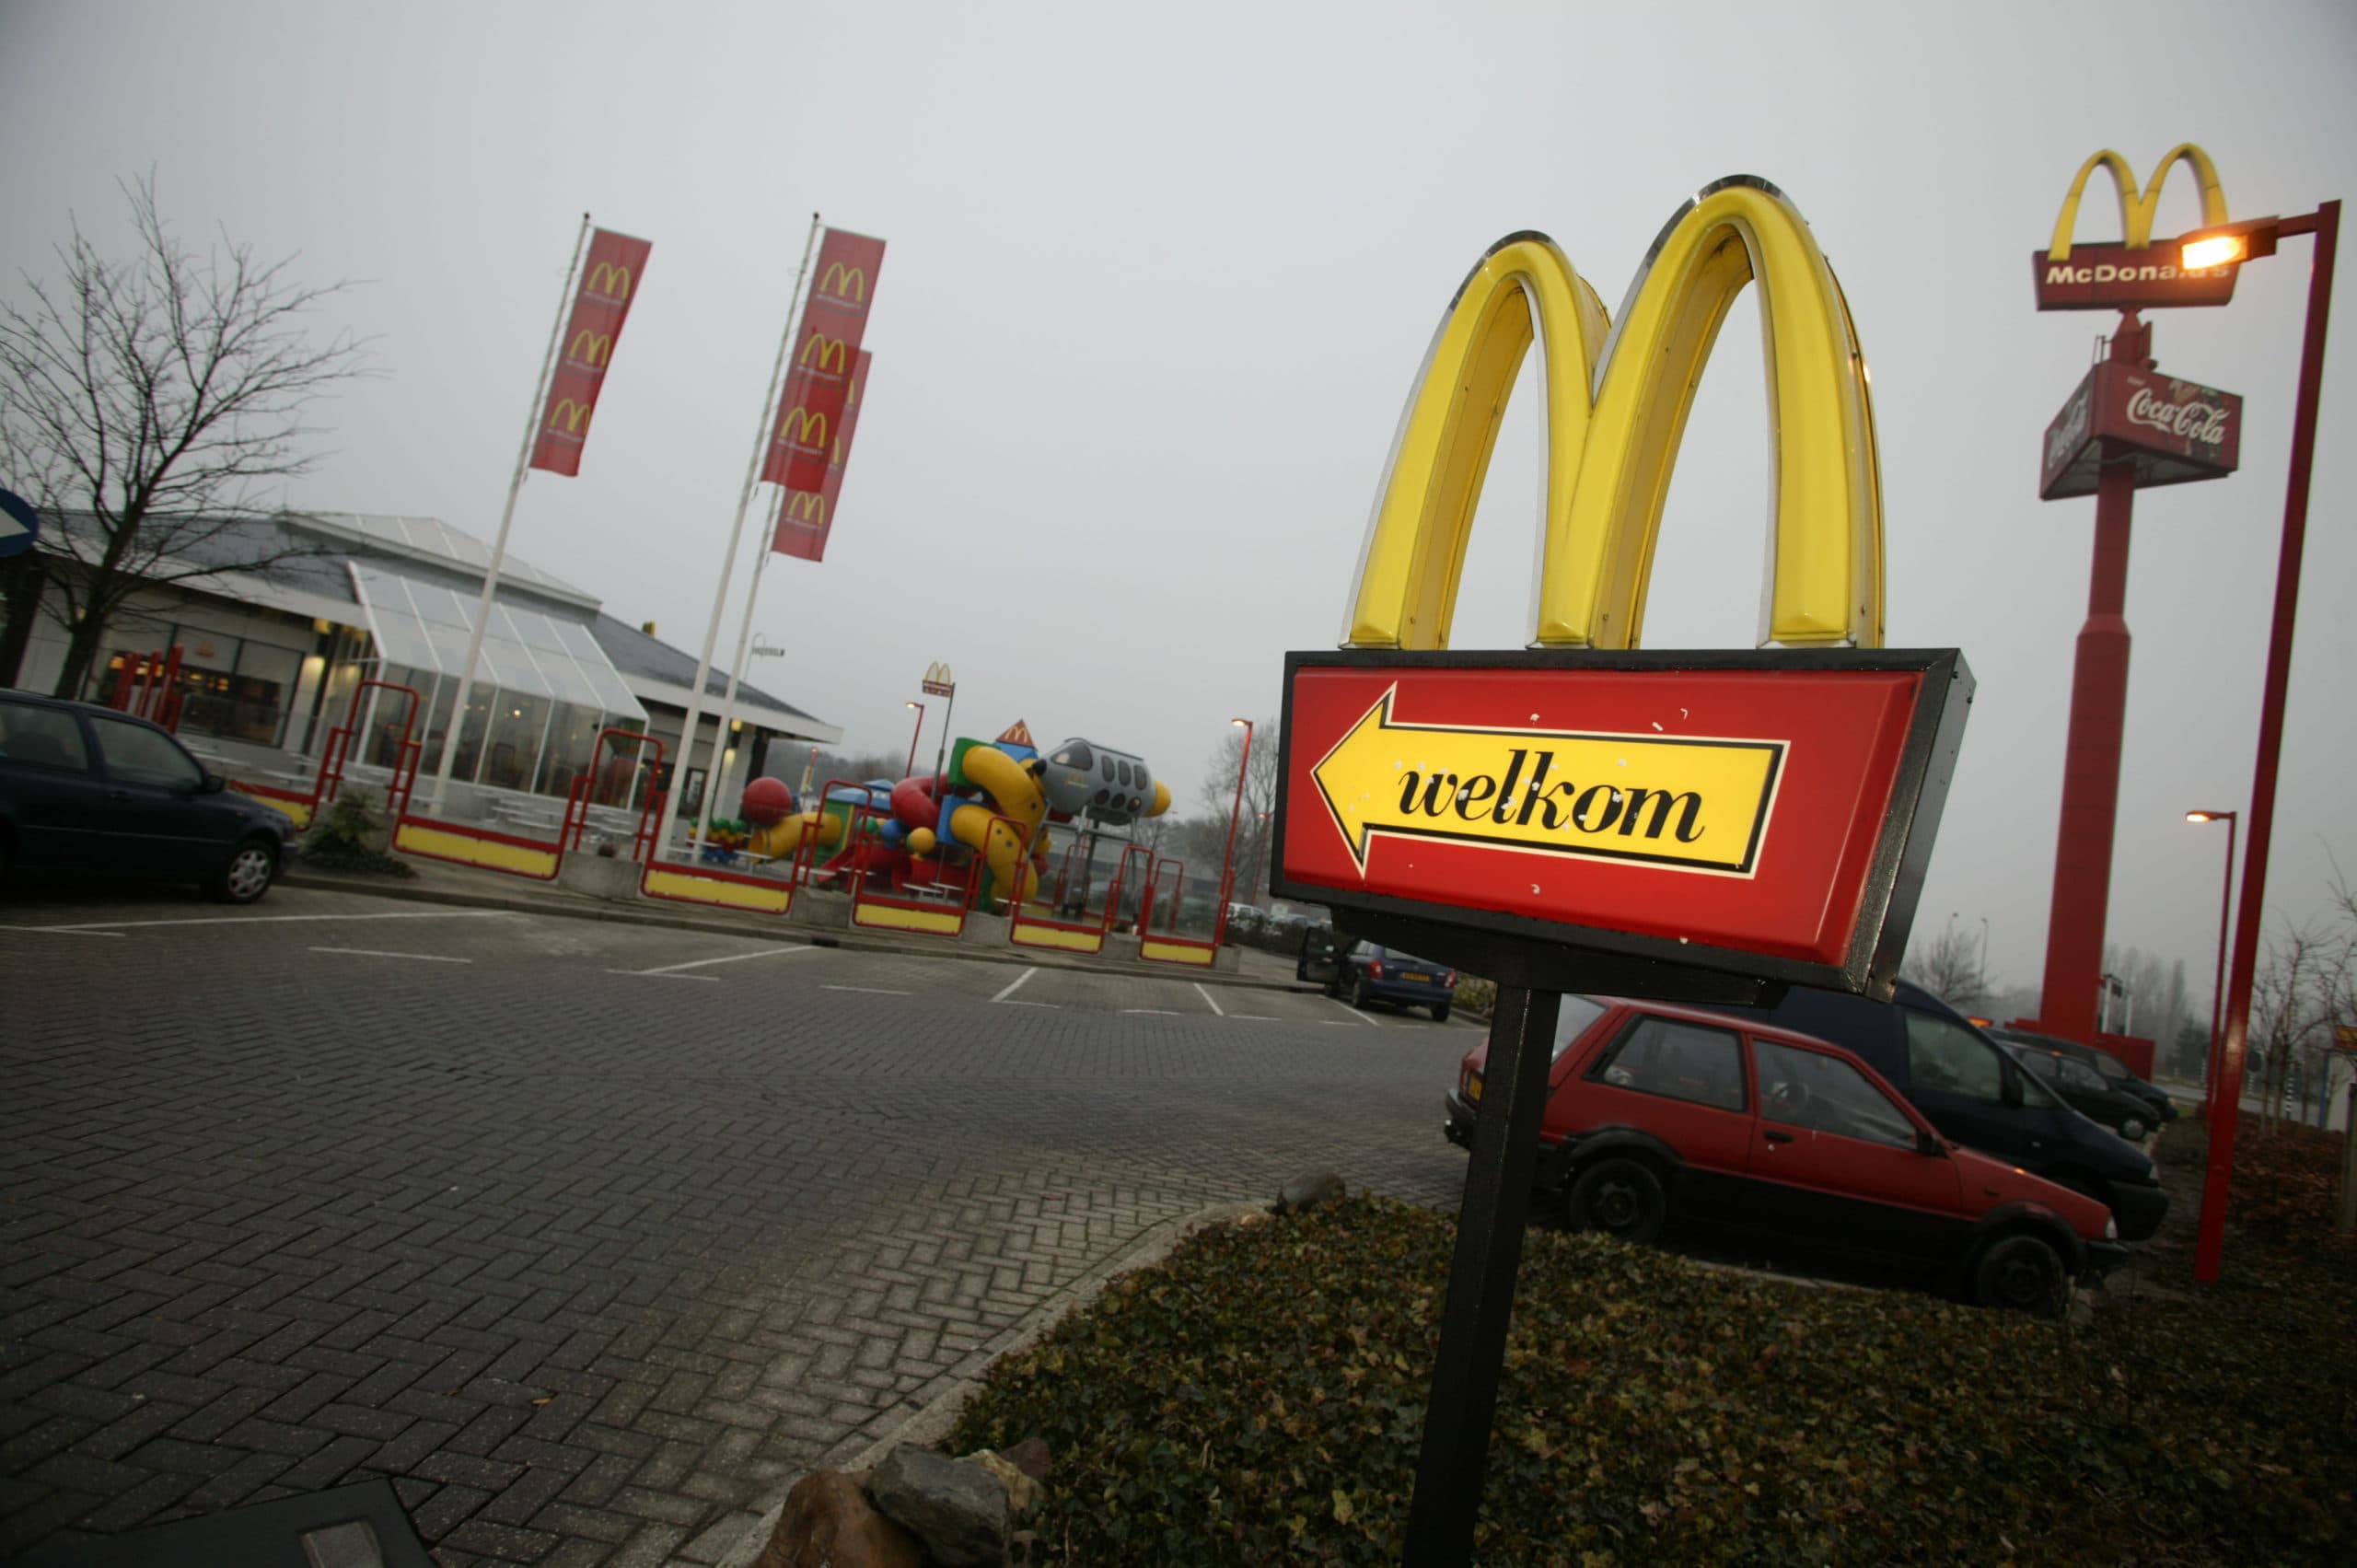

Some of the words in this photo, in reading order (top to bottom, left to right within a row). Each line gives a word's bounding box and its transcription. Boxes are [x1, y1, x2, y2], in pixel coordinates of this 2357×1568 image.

[2046, 264, 2230, 285] McDonas
[2126, 388, 2230, 445] Coca-Cola
[1398, 749, 1706, 842] welkom
